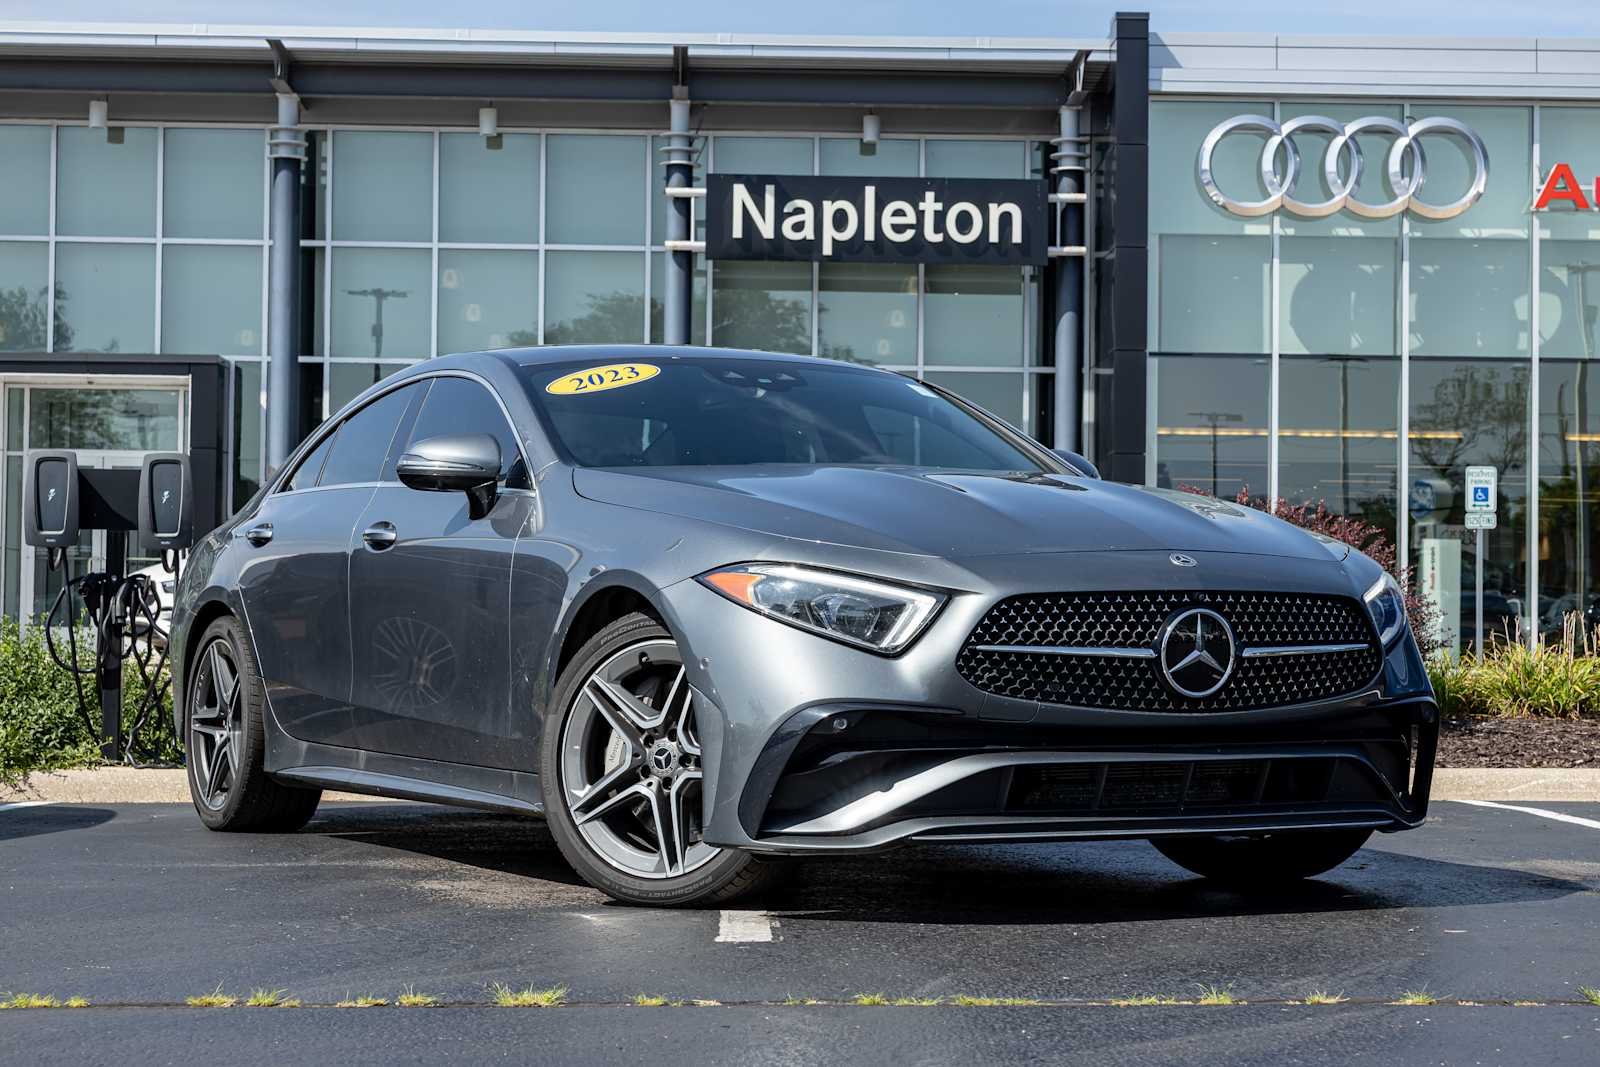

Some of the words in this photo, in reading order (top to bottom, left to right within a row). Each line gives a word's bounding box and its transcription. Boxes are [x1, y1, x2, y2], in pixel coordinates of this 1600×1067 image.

[1534, 163, 1600, 209] A
[732, 184, 1022, 256] Napleton
[569, 366, 640, 391] 2023
